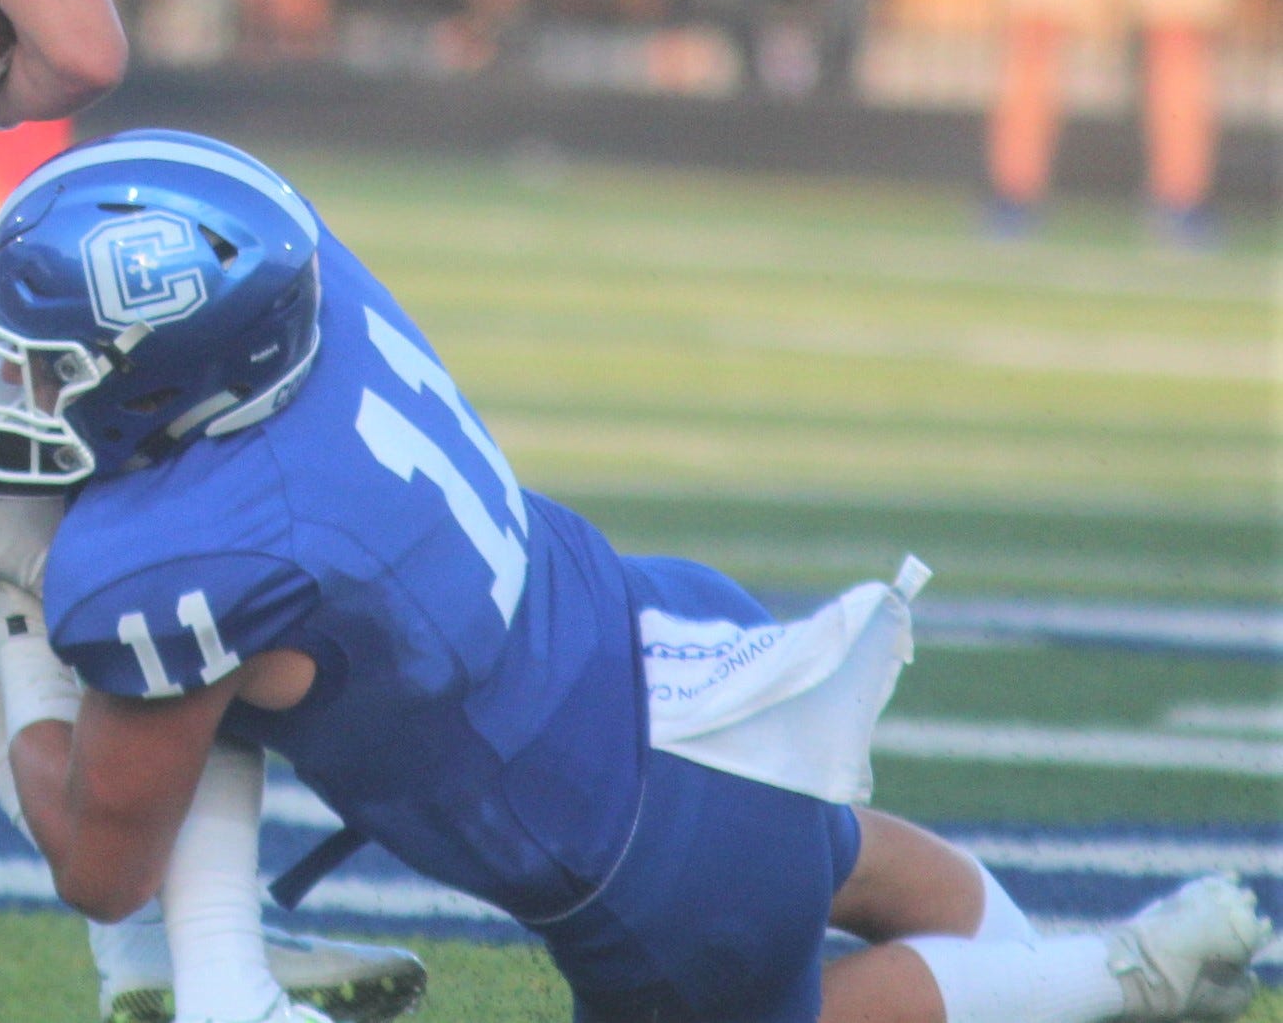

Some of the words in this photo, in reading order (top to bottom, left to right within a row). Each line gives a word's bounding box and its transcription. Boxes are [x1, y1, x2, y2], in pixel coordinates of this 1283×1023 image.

[80, 210, 208, 332] C
[354, 304, 529, 632] 11
[117, 589, 241, 700] 11
[678, 629, 786, 701] OVINGTN
